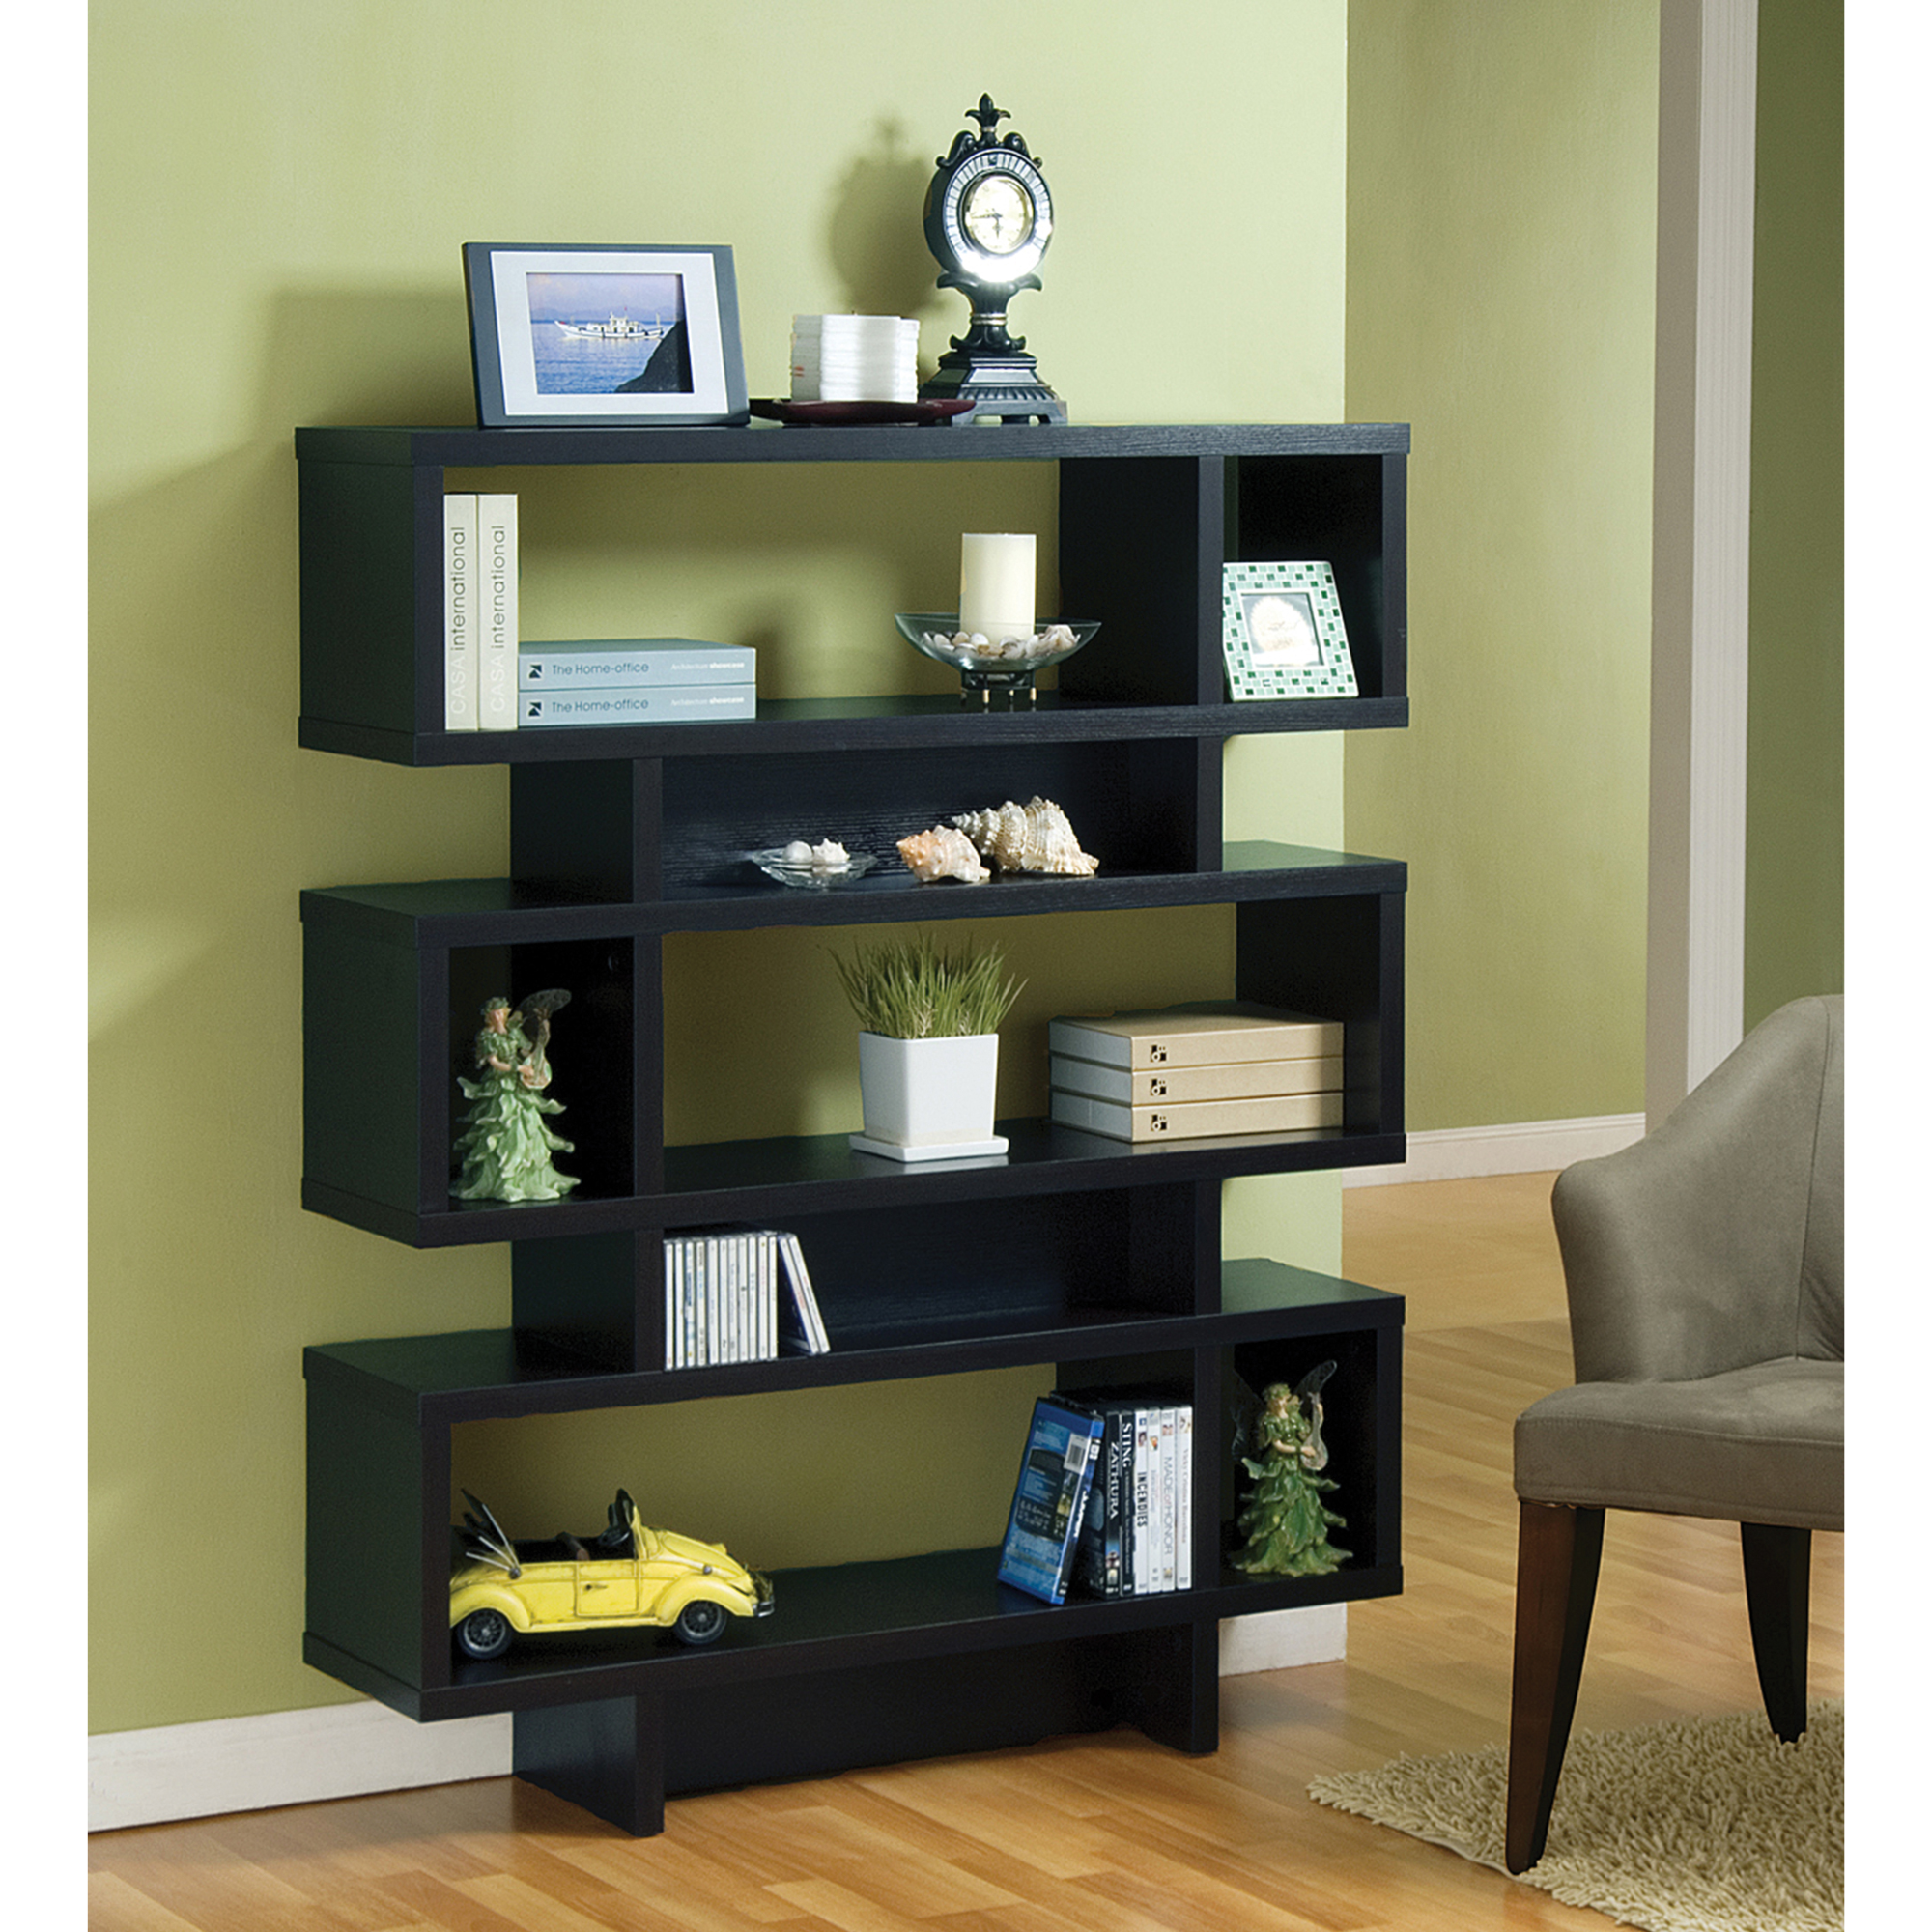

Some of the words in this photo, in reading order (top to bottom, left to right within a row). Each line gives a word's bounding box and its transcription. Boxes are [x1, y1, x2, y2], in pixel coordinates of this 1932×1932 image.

[450, 526, 466, 651] international
[491, 526, 505, 649] international
[450, 656, 466, 715] CASA
[491, 654, 505, 712] CASA
[553, 664, 573, 675] The
[575, 663, 649, 675] Home-office
[552, 701, 573, 713] The
[575, 699, 649, 712] Home-office
[1122, 1422, 1133, 1468] STING
[1110, 1441, 1120, 1520] ZATHURA
[1137, 1471, 1148, 1528] INCENDIES
